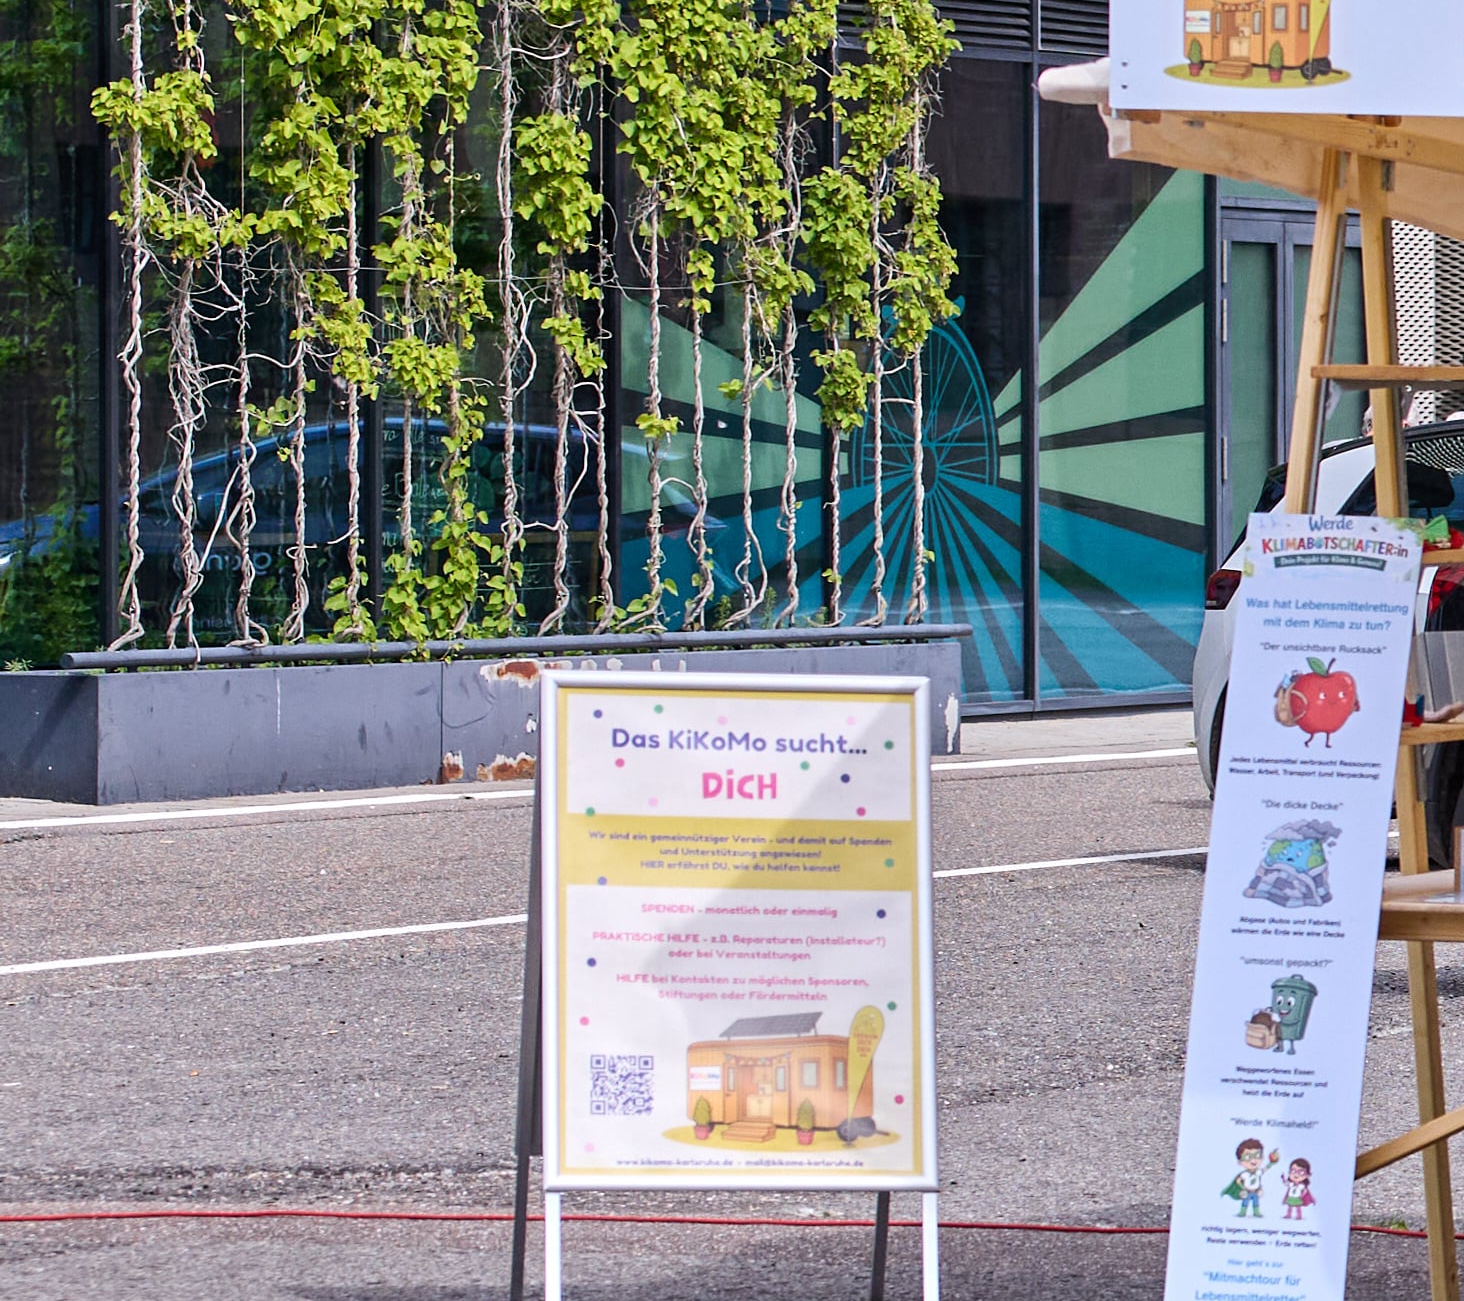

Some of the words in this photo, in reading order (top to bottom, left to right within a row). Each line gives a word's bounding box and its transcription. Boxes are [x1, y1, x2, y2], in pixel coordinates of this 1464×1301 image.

[1309, 515, 1354, 531] Werde
[1262, 537, 1408, 558] KLIMABOTSCHAFTER:in
[1246, 598, 1269, 608] Was
[1273, 599, 1292, 609] hat
[1295, 600, 1409, 615] Lebensmittelrettung
[1263, 618, 1282, 626] mit
[1285, 618, 1310, 627] dem
[1313, 619, 1345, 629] Klima
[1349, 622, 1362, 630] zu
[1366, 621, 1391, 631] tun?
[611, 728, 660, 749] Das
[668, 730, 767, 752] KiKoMo
[776, 733, 867, 755] sucht...
[642, 904, 694, 914] SPENDEN
[705, 905, 760, 916] monatlich
[763, 906, 788, 916] oder
[792, 907, 837, 918] einmalig
[593, 931, 665, 942] PRAKTISCHE
[667, 933, 700, 943] HILFE
[733, 935, 803, 946] Reparaturen
[668, 950, 693, 958] oder
[697, 949, 713, 958] bei
[716, 950, 811, 961] Veranstaltungen
[616, 974, 649, 983] HILFE
[652, 974, 668, 984] bei
[671, 975, 729, 984] Kontakten
[732, 977, 746, 985] zu
[749, 976, 805, 987] möglichen
[1285, 1275, 1301, 1286] für
